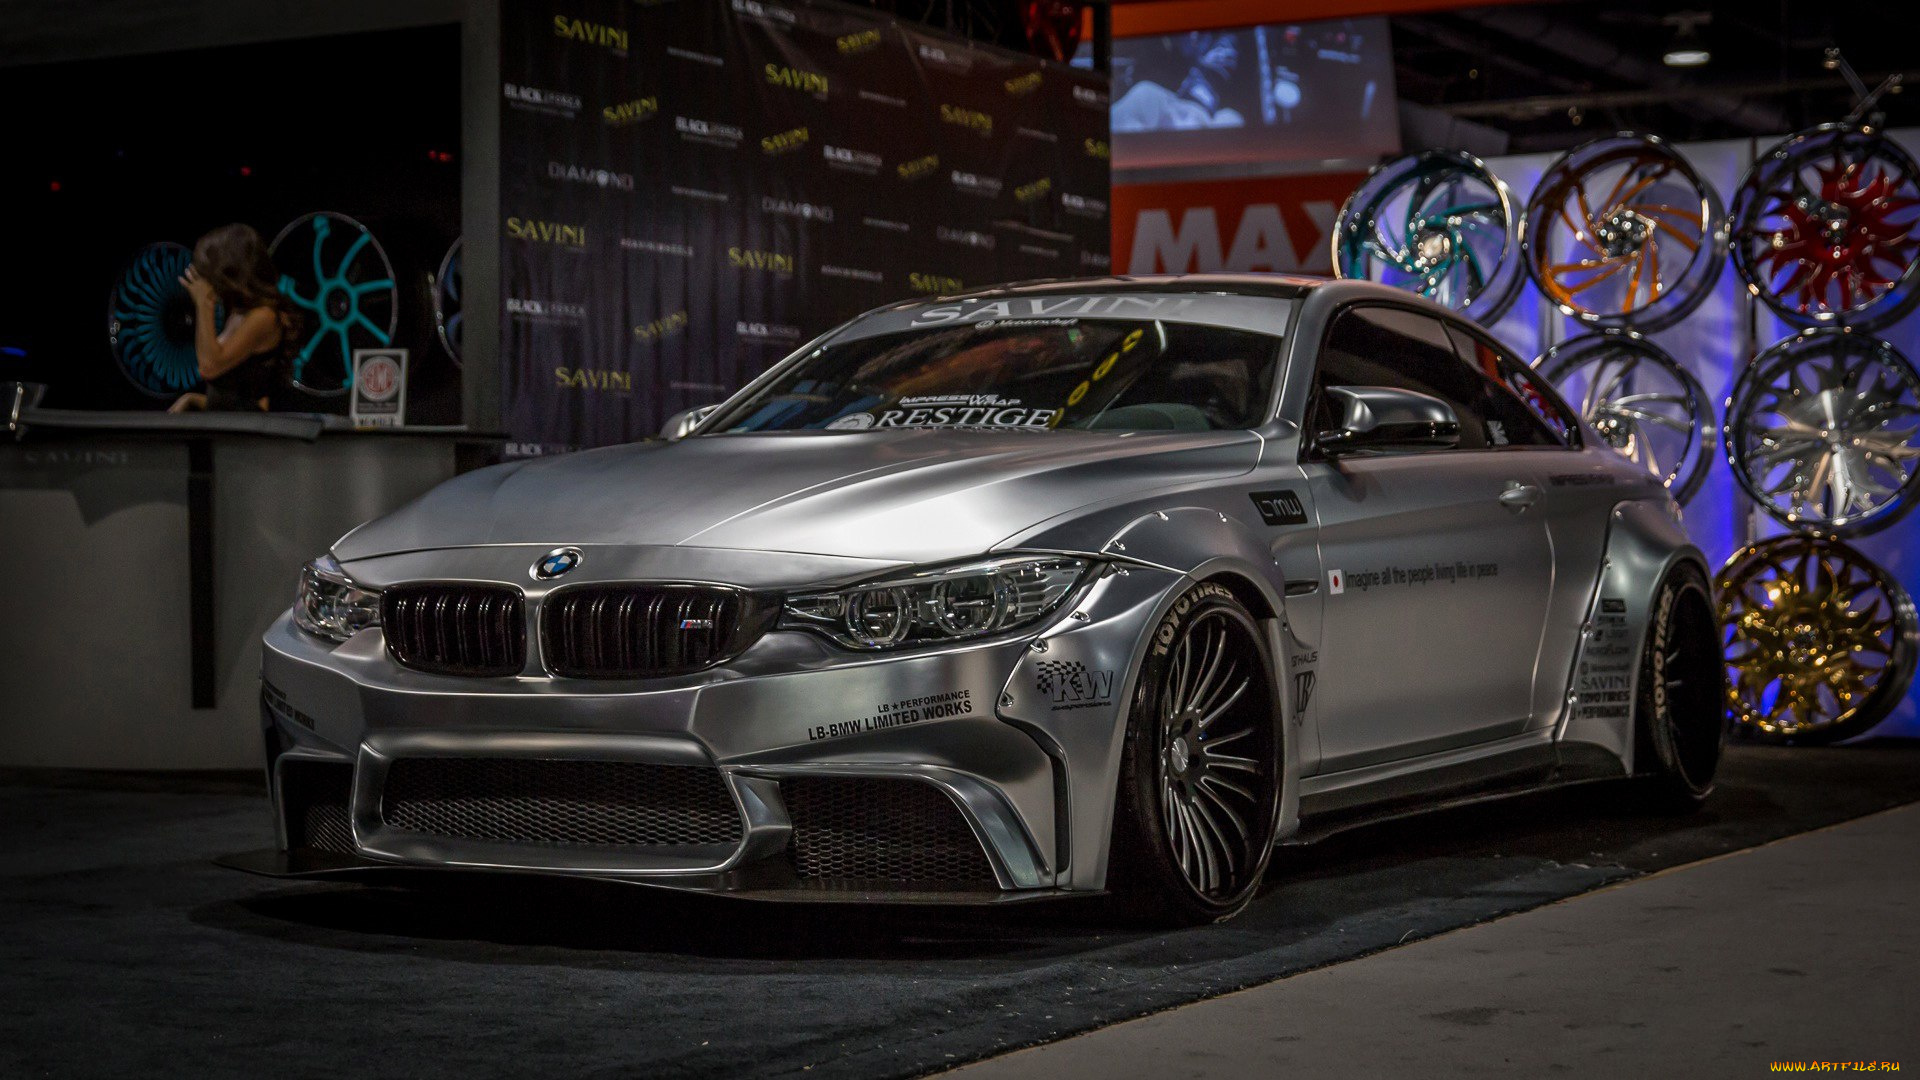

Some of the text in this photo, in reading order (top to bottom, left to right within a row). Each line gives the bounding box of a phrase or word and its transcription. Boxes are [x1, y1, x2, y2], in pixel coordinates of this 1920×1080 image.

[554, 14, 629, 50] SAVINI
[836, 29, 881, 52] SAVINI
[765, 62, 828, 93] SAVINI
[504, 82, 543, 103] BLACK
[603, 95, 658, 121] SAVINI
[940, 103, 993, 131] SAVINI
[675, 115, 709, 135] BLACK
[761, 126, 809, 151] SAVINI
[549, 161, 634, 192] DIAMOND
[897, 154, 939, 177] SAVINI
[762, 196, 833, 223] DIAMOND
[507, 217, 586, 247] SAVINI
[729, 247, 793, 273] SAVINI
[909, 272, 963, 293] SAVINI
[506, 298, 543, 315] BLACK
[911, 296, 1197, 327] SAVINI
[634, 310, 689, 340] SAVINI
[736, 321, 768, 336] BLACK
[554, 367, 631, 391] SAVINI
[505, 442, 543, 456] BLACK
[1344, 569, 1380, 591] Imagine
[1381, 566, 1391, 585] all
[1392, 566, 1407, 584] the
[1408, 564, 1434, 588] people
[1456, 561, 1468, 578] life
[1469, 561, 1476, 577] in
[1477, 563, 1498, 580] peace
[1152, 581, 1235, 656] TOYO TIRES
[1052, 670, 1114, 702] KW
[1581, 676, 1630, 690] SAVINI
[877, 690, 970, 714] LB PERFORMANCE
[1580, 690, 1630, 704] TOYO TIRES
[808, 700, 972, 741] LB-BMW LIMITED WORKS
